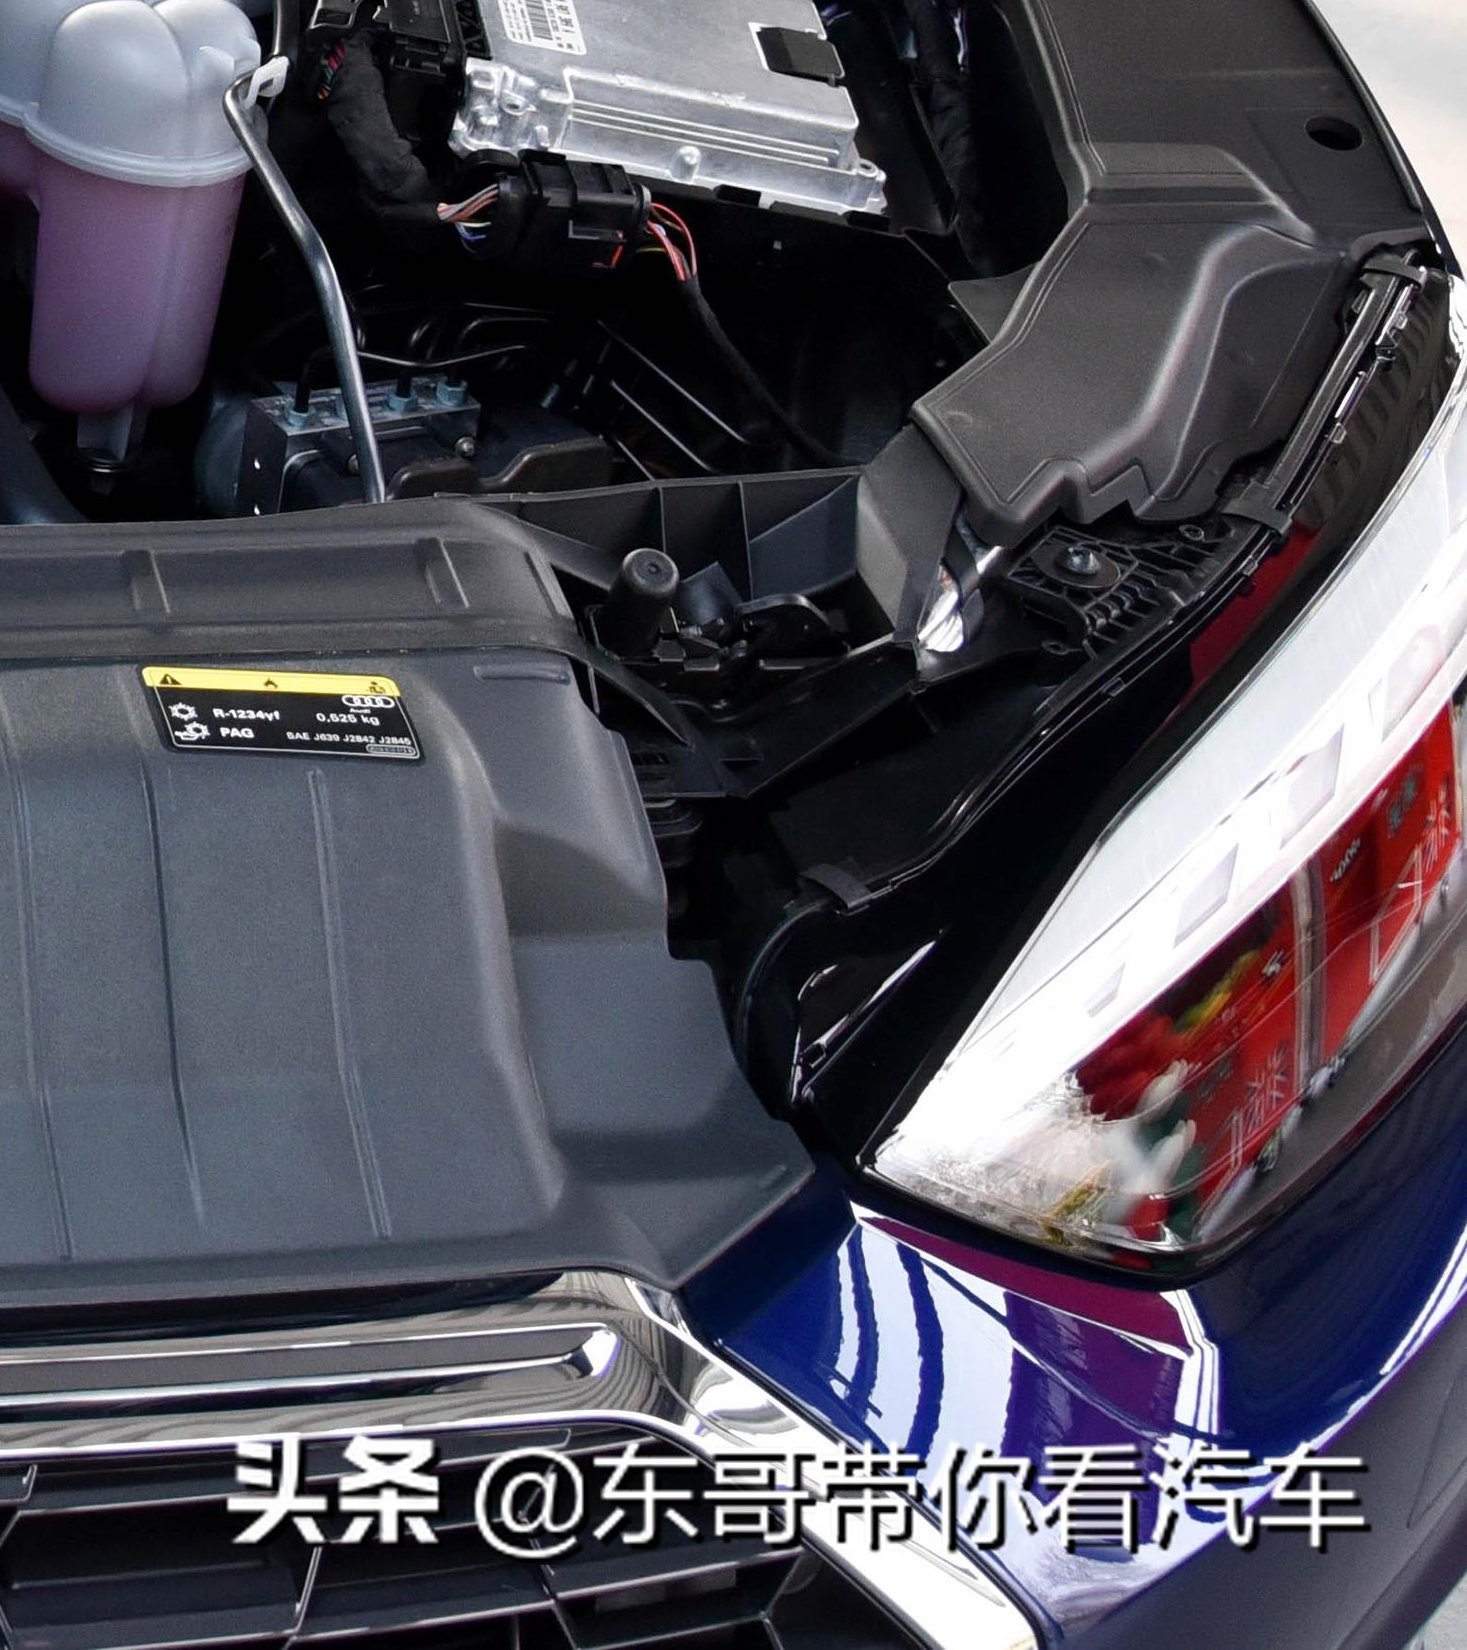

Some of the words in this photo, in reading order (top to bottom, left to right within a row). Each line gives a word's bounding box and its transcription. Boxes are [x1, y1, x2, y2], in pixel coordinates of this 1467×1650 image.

[212, 708, 281, 722] R-1234yf
[360, 714, 381, 727] kg
[219, 726, 255, 739] PAG
[286, 731, 310, 741] SAE
[313, 732, 341, 742] J639
[342, 734, 376, 744] J2842
